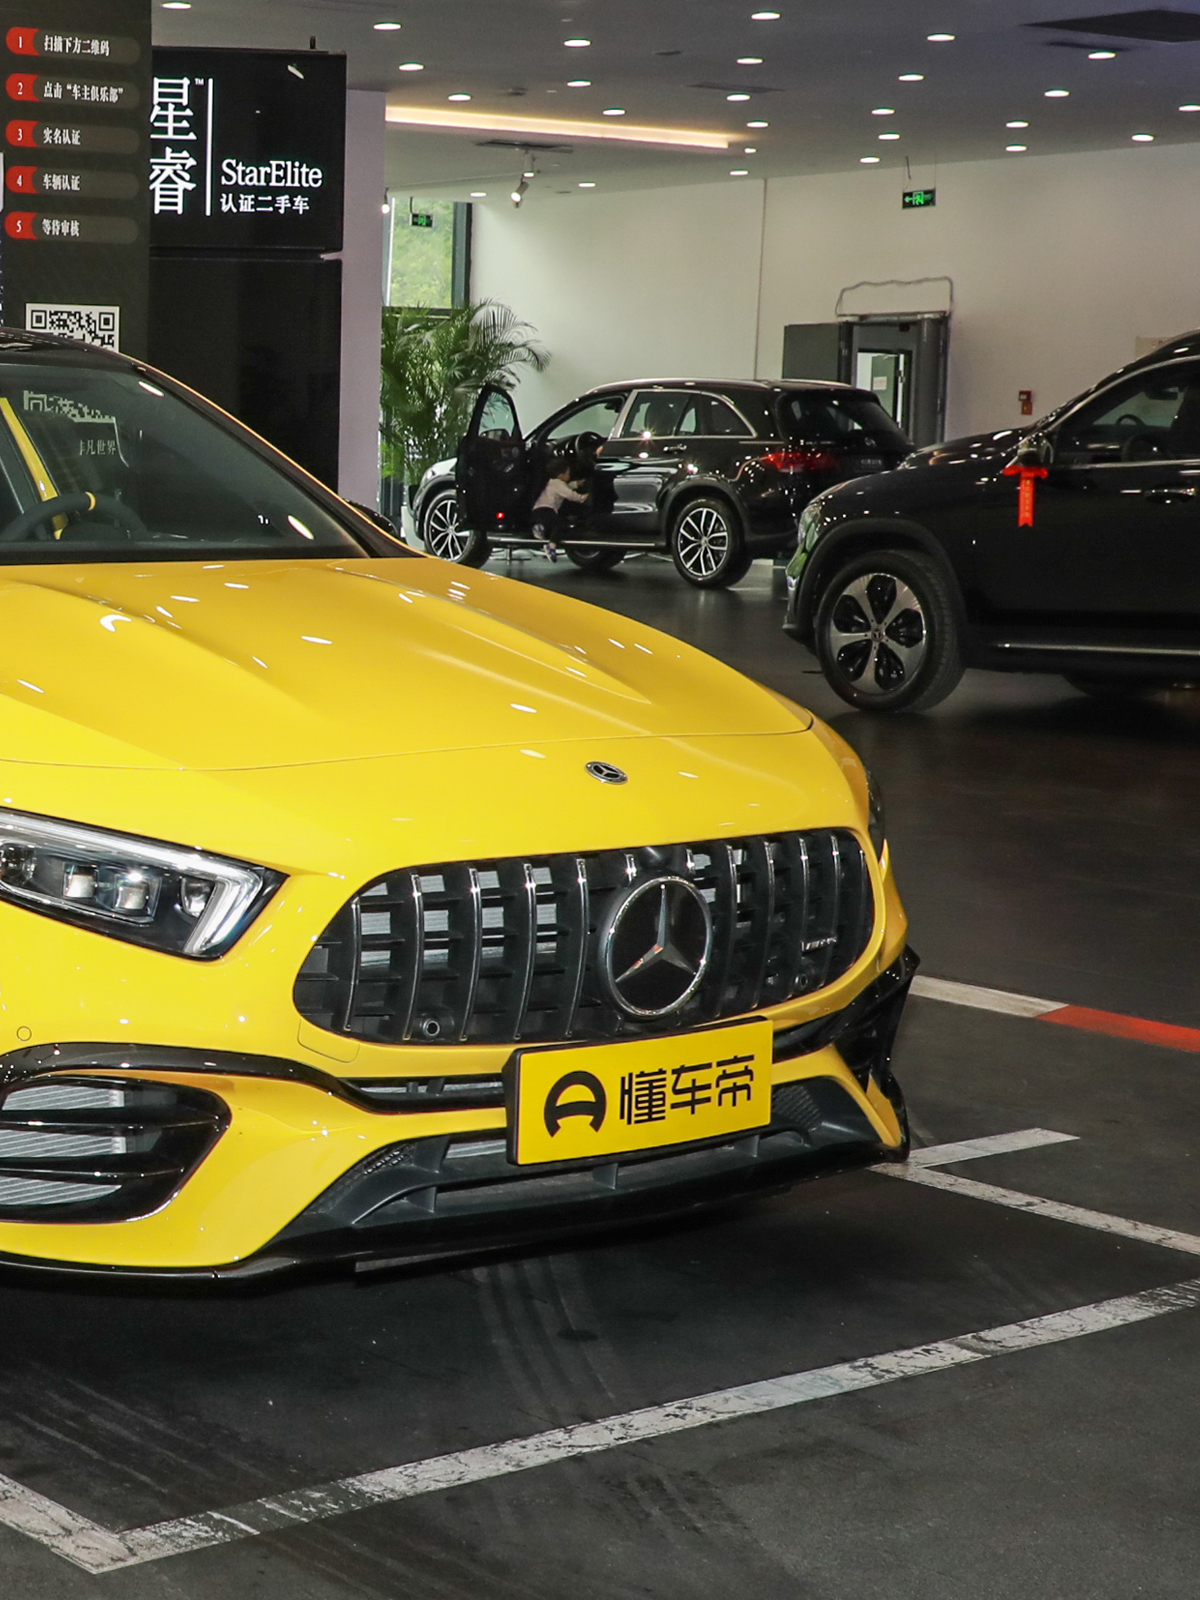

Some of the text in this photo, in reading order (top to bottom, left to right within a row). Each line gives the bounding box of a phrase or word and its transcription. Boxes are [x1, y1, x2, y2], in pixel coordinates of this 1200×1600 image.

[43, 34, 110, 56] 扫描下方二维码
[17, 82, 23, 95] 2
[17, 127, 81, 145] 3 实名认证
[149, 77, 197, 215] 星睿
[16, 173, 80, 191] 4 车辆认证
[221, 159, 322, 187] StarElite
[220, 193, 309, 214] 认证二手车
[16, 218, 79, 237] 5 等待审核
[620, 1054, 755, 1126] 懂车帝
